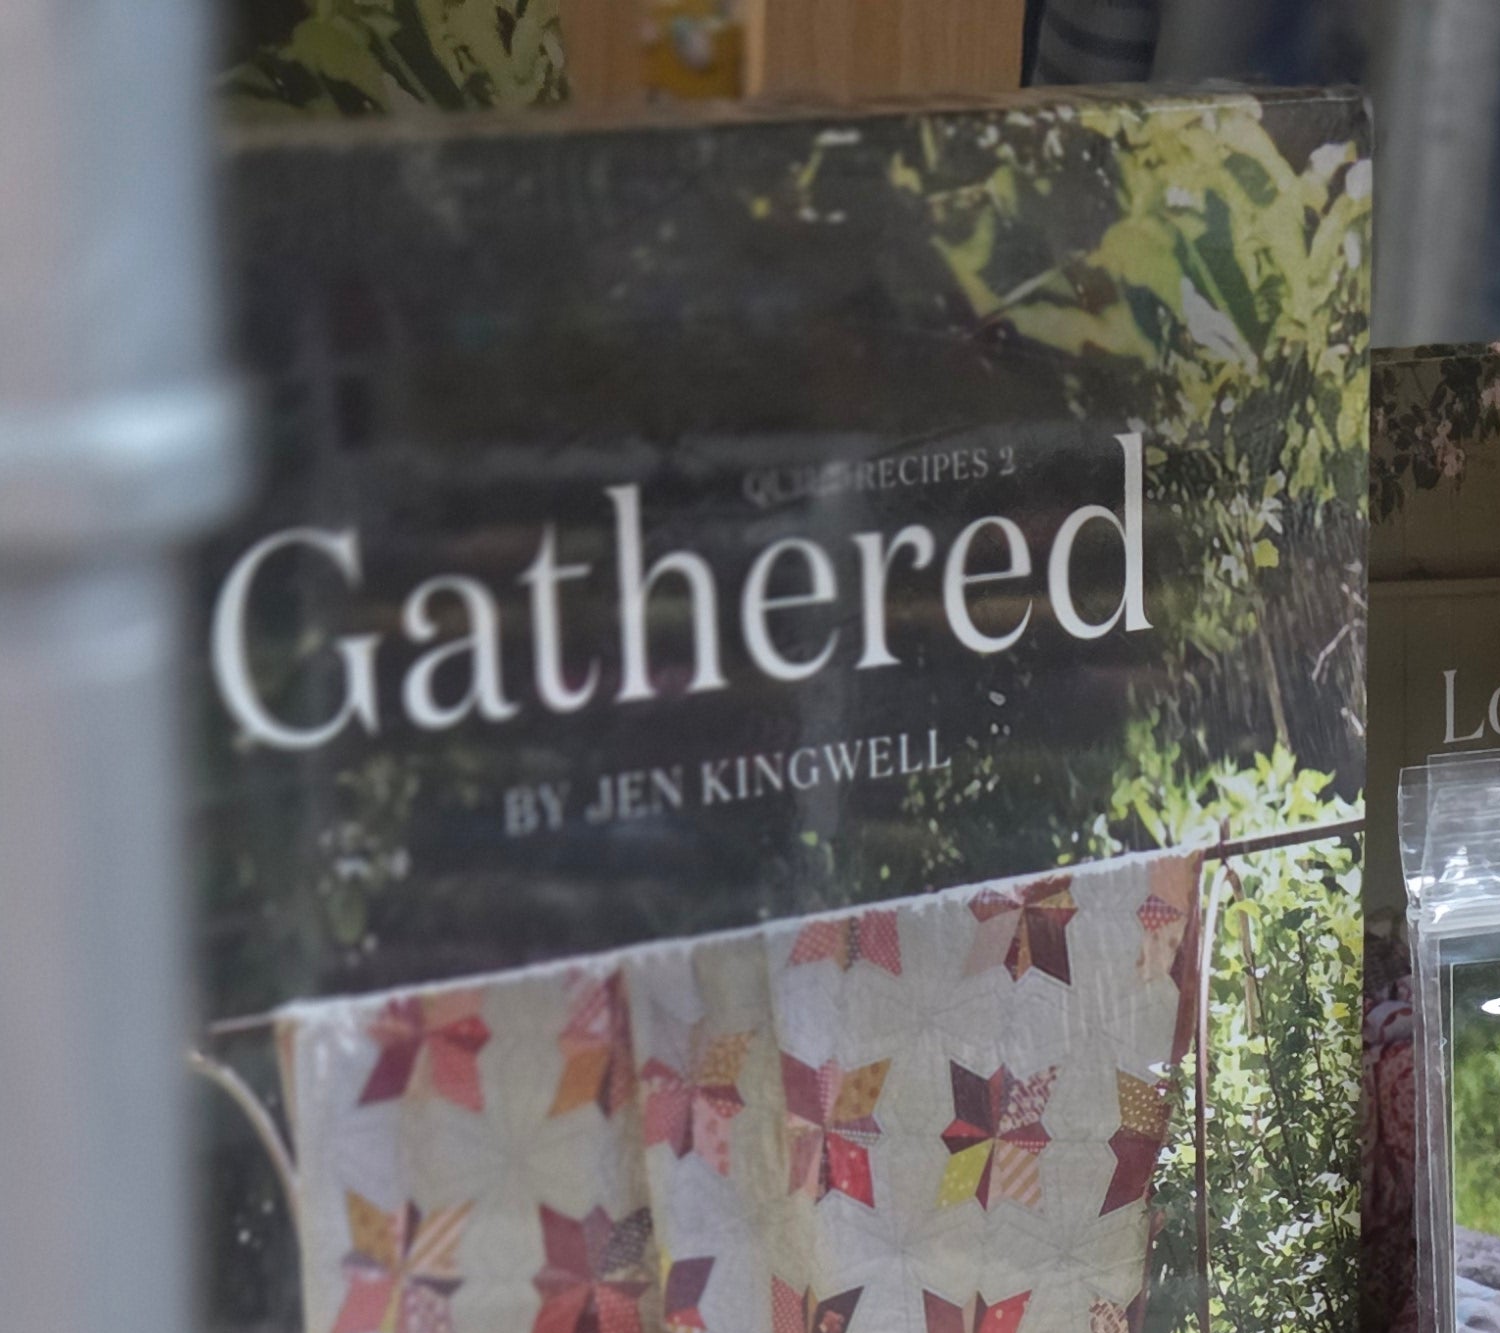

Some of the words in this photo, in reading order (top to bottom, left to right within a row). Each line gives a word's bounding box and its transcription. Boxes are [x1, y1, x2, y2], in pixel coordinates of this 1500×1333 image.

[855, 449, 989, 491] RECIPES
[999, 445, 1015, 476] 2
[210, 433, 1154, 751] Gathered
[504, 781, 570, 838] BY
[585, 765, 684, 825] JEN
[702, 729, 952, 805] KINGWELL
